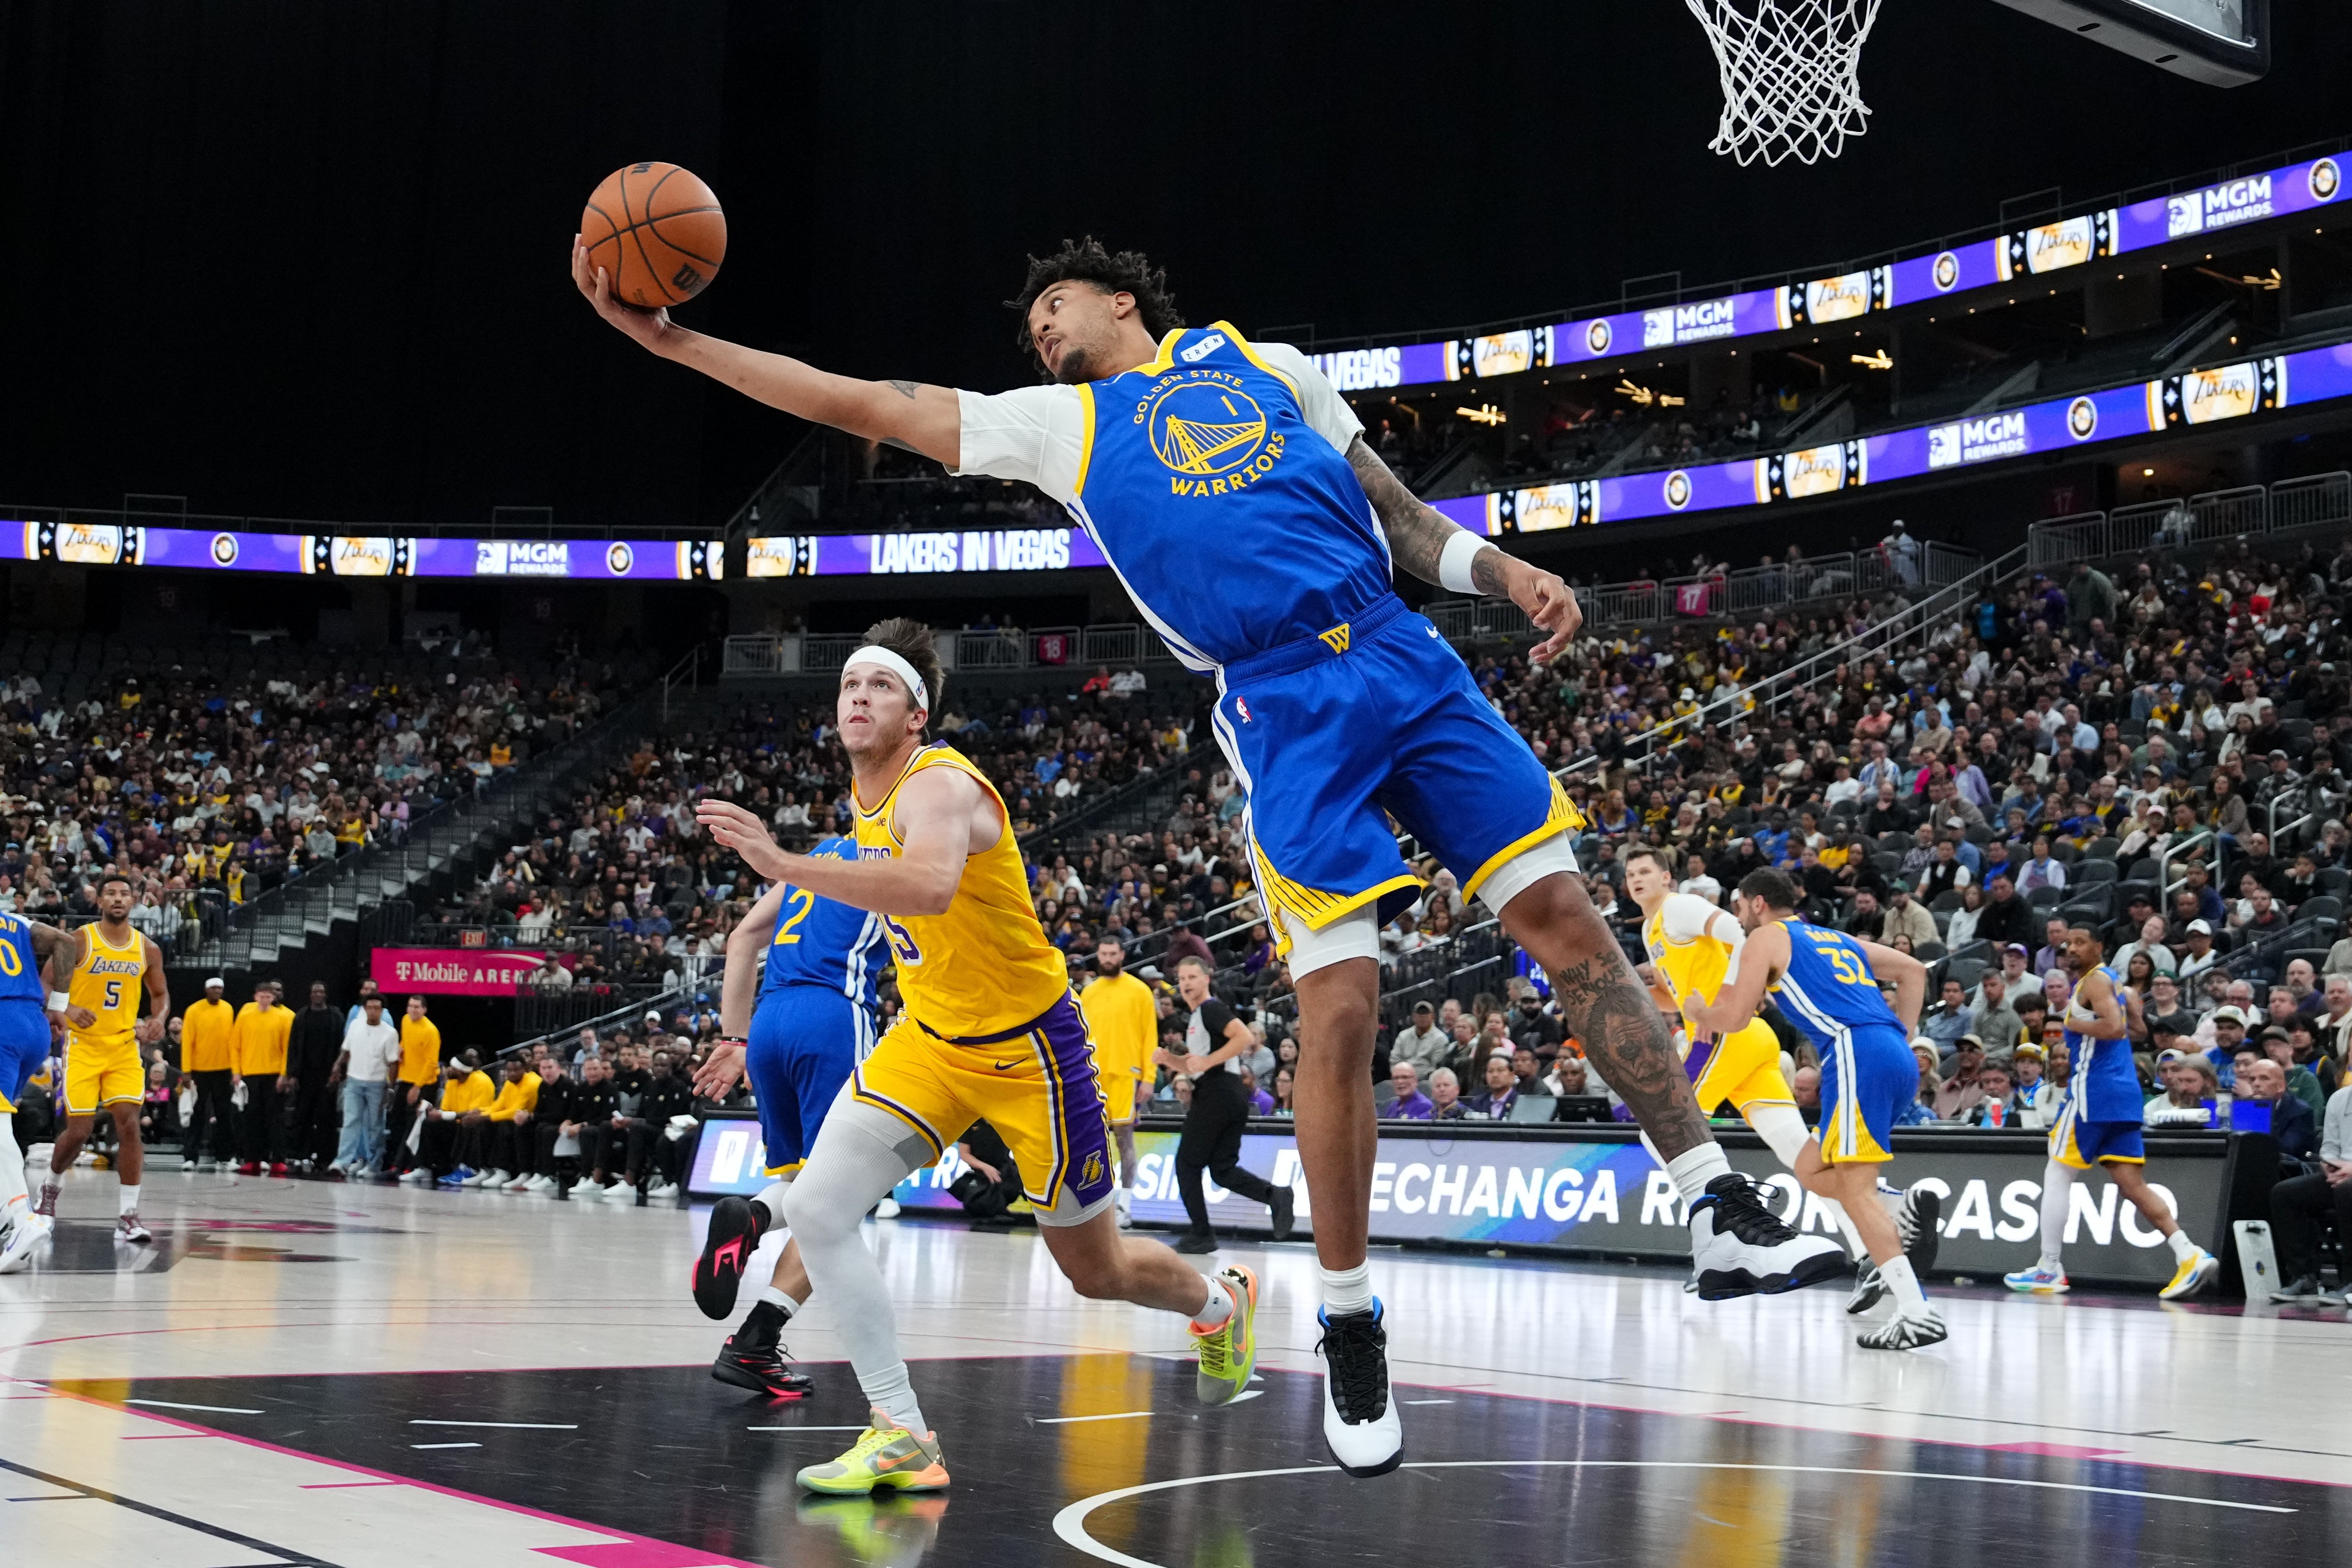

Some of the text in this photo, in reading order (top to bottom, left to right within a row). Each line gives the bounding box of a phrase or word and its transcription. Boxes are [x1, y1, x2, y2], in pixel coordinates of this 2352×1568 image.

[2206, 175, 2272, 212] MGM
[2207, 202, 2271, 228] REWARDS
[1677, 299, 1734, 329] MGM
[1677, 322, 1735, 343] REWARDS
[1186, 337, 1219, 359] IREN
[1327, 346, 1400, 392] VEGAS
[1134, 370, 1243, 424] GOLDEN STATE
[1963, 412, 2025, 446] MGM
[1171, 431, 1285, 497] WARRIORS
[1964, 438, 2026, 461] REWARDS
[510, 543, 565, 561] MGM
[870, 528, 1070, 574] LAKERS IN VEGAS
[510, 562, 567, 574] REWARDS
[1683, 585, 1700, 611] 17
[775, 889, 814, 945] 2
[88, 956, 140, 977] LAKERS
[1816, 947, 1878, 988] 32
[103, 980, 122, 1010] 5
[1369, 1162, 1619, 1224] ECHANGA
[1911, 1177, 2178, 1248] ASNO
